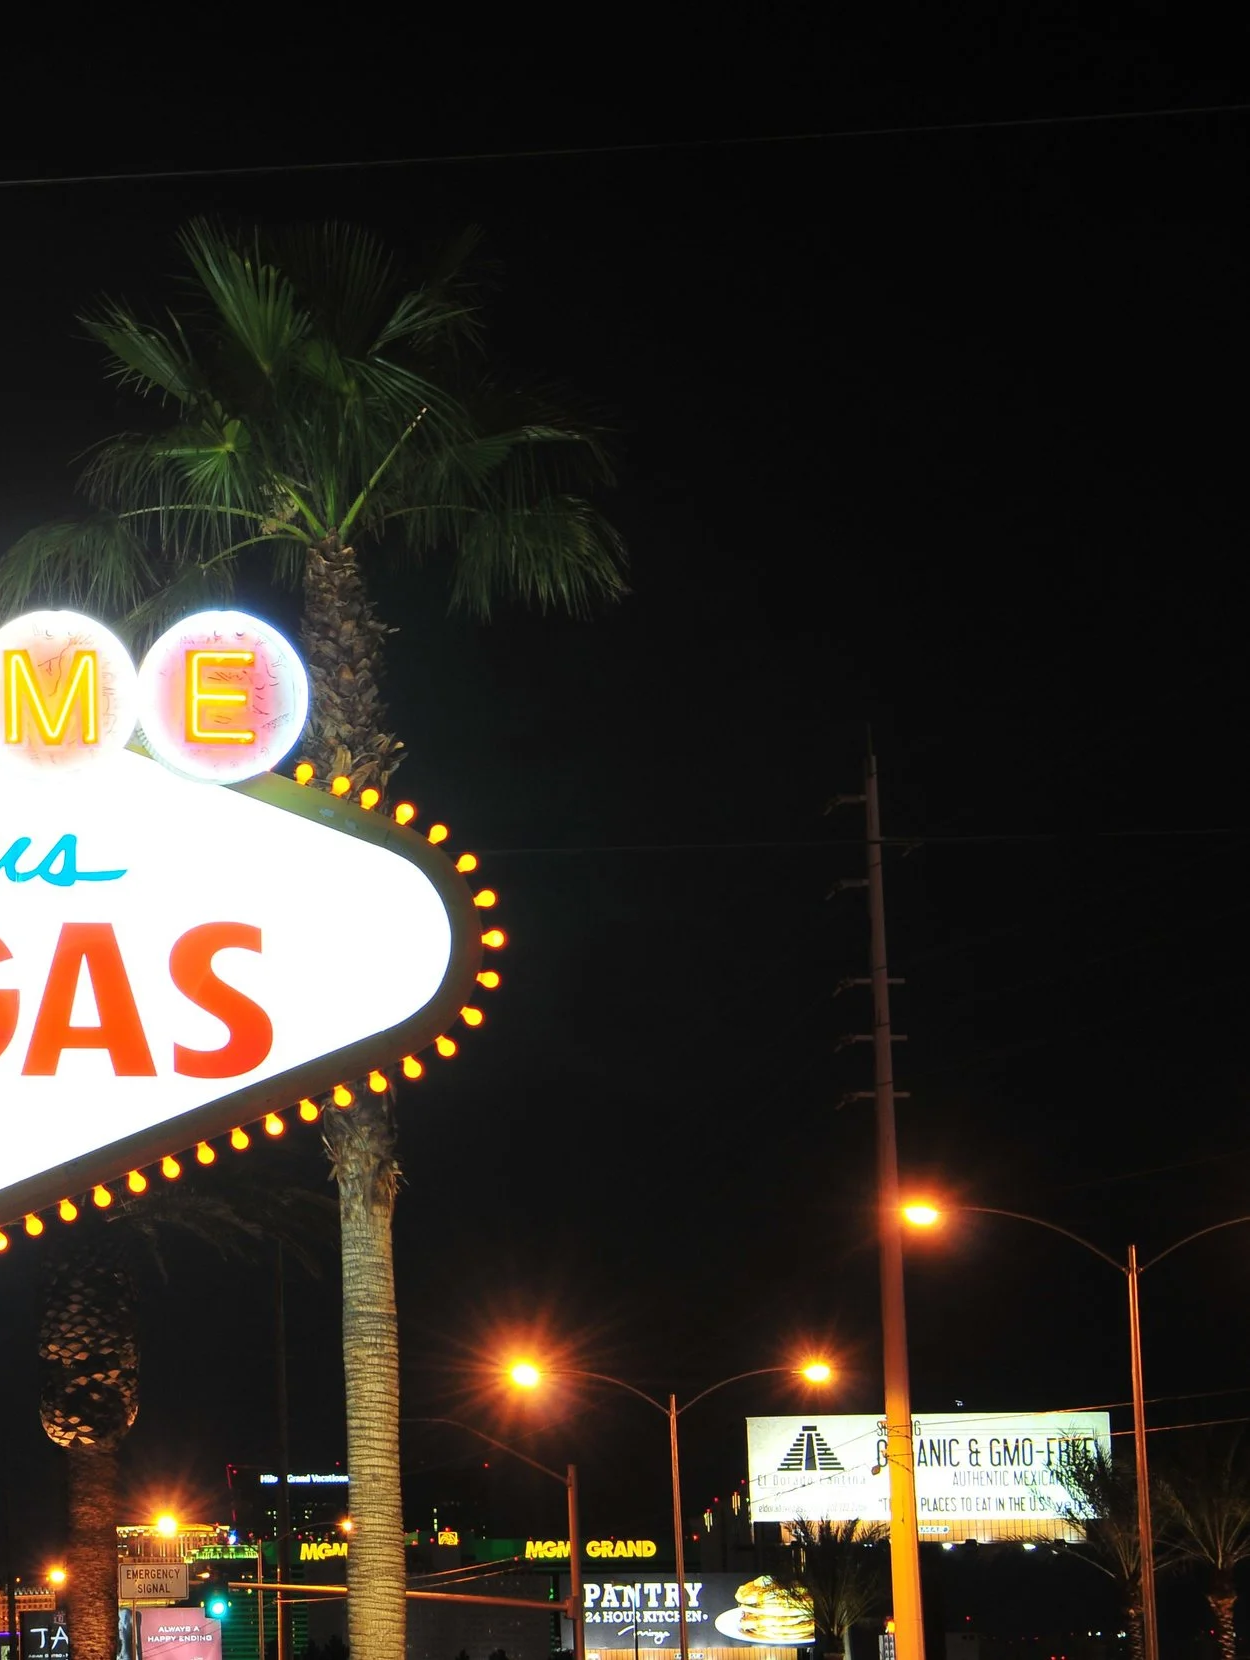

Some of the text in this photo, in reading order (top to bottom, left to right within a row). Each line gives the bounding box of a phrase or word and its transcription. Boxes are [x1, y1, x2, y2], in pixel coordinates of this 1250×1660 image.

[876, 1438, 960, 1467] OANIC
[968, 1438, 981, 1467] &
[953, 1470, 1009, 1487] AUTHENTIC
[920, 1497, 957, 1512] PLACES
[961, 1497, 971, 1512] TO
[976, 1497, 991, 1512] EAT
[995, 1497, 1005, 1512] IN
[1009, 1497, 1026, 1512] THE
[585, 1540, 657, 1558] GRAND
[126, 1569, 181, 1580] EMERGENCY
[137, 1583, 171, 1594] SIGNAL
[583, 1582, 703, 1608] PANTRY
[585, 1610, 602, 1623] 24
[603, 1610, 642, 1623] HOUR
[158, 1625, 200, 1633] ALWAYS A
[147, 1634, 213, 1643] HAPPY ENDING
